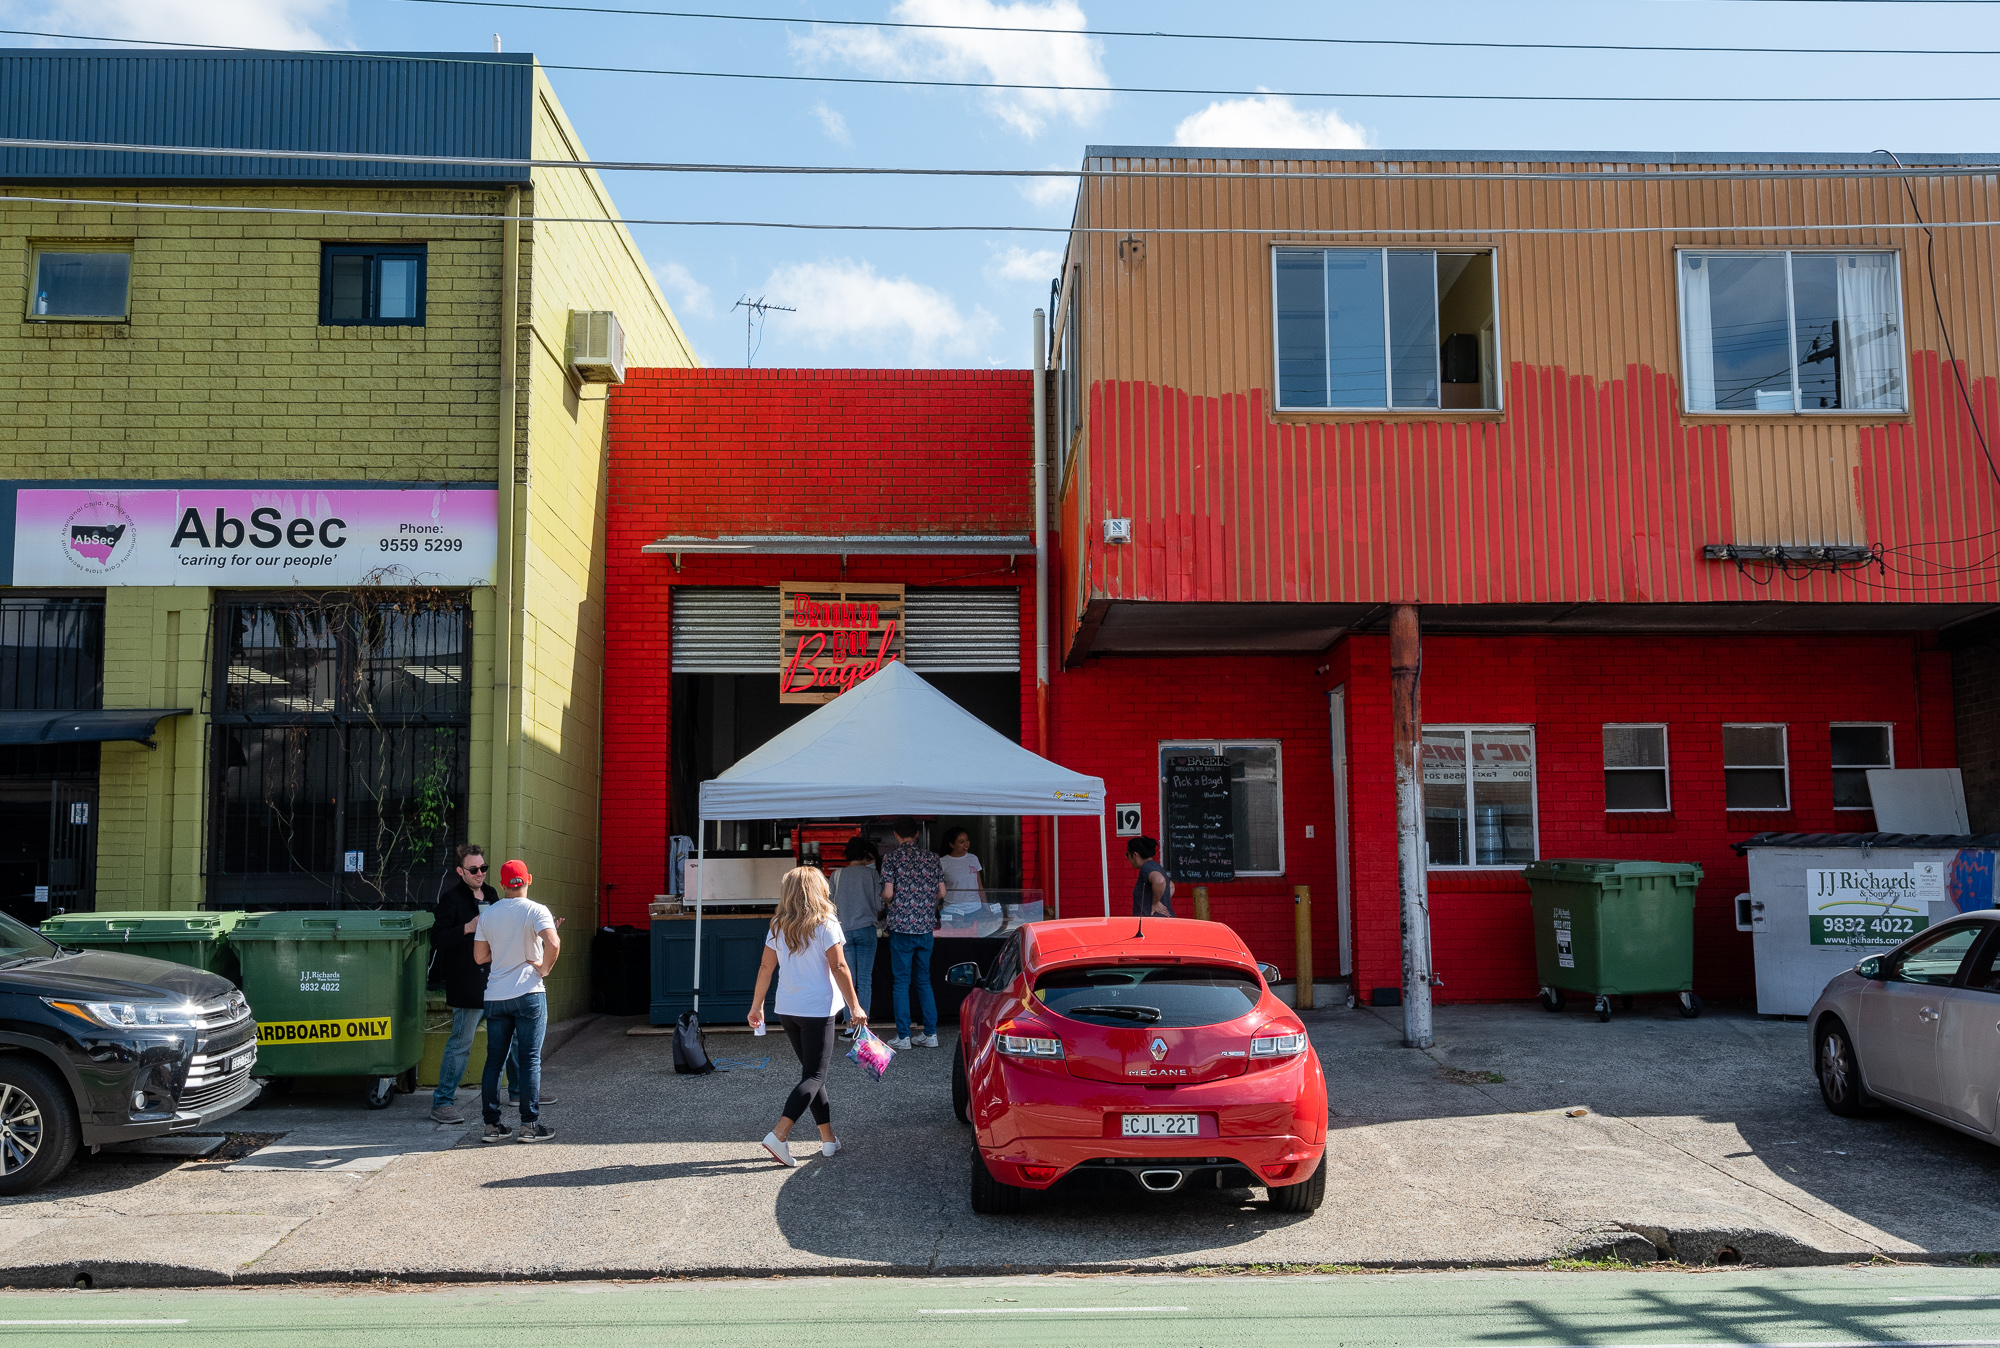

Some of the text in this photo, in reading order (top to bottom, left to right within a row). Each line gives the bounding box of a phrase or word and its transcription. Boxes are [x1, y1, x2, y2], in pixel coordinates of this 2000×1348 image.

[84, 501, 104, 509] Child,
[106, 501, 126, 515] Family
[62, 506, 83, 536] Aboriginal
[126, 514, 135, 527] and
[170, 506, 347, 549] AbSec
[400, 523, 444, 534] Phone:
[74, 534, 115, 545] AbSec
[120, 528, 137, 564] Community
[380, 538, 462, 552] 9559 5299
[61, 539, 84, 571] Secretariat
[231, 554, 252, 566] for
[255, 556, 281, 566] our
[104, 562, 121, 573] Care
[781, 620, 898, 697] Bagel
[1170, 756, 1231, 767] I BAGELS
[1172, 775, 1192, 788] Pick
[1201, 774, 1224, 789] Bagel
[1117, 810, 1140, 830] 19
[1205, 870, 1210, 878] A
[1860, 890, 1866, 898] &
[1823, 917, 1914, 933] 9832 4022
[300, 982, 340, 992] 9832 4022
[256, 1020, 388, 1041] ARDBOARD ONLY
